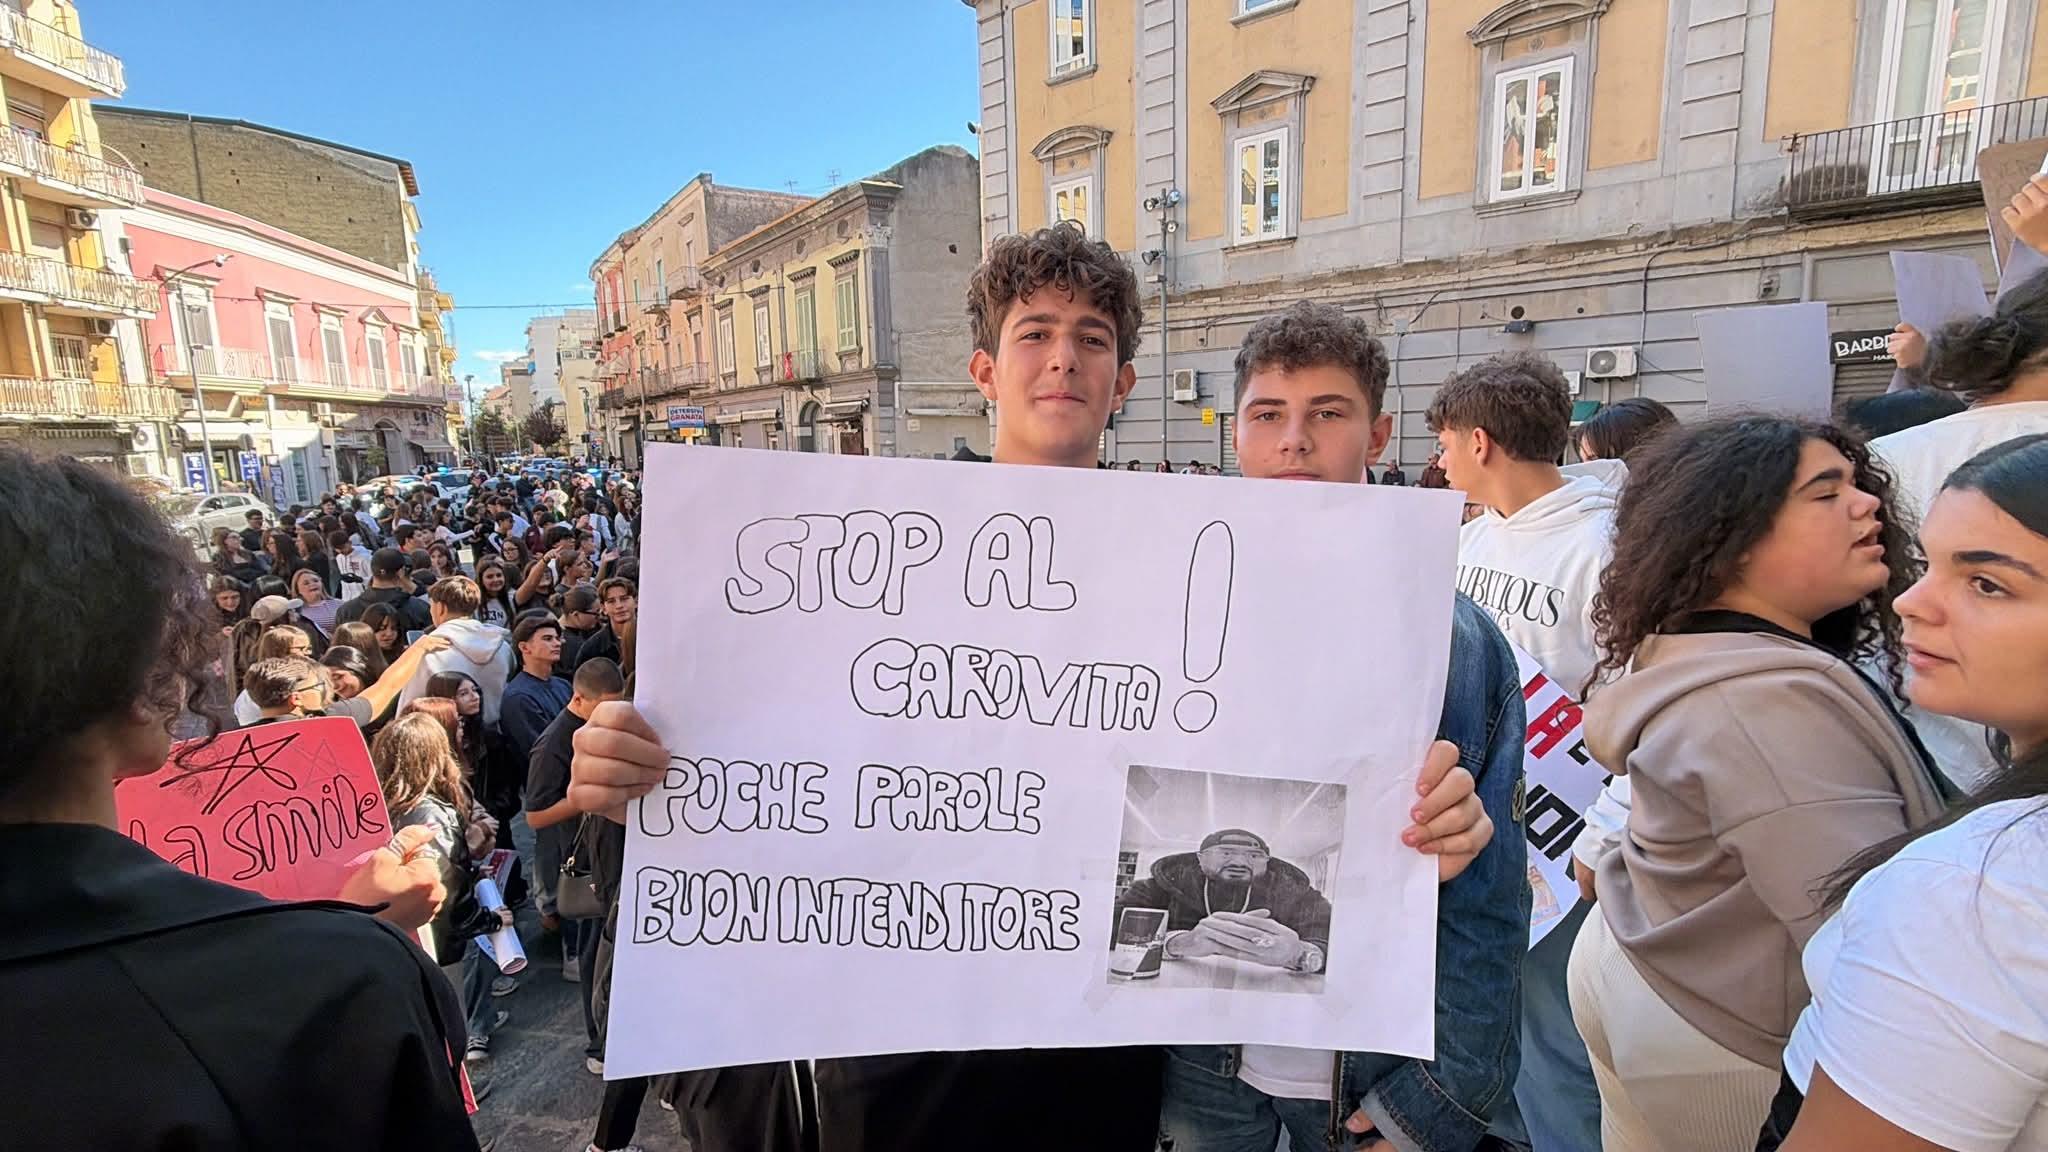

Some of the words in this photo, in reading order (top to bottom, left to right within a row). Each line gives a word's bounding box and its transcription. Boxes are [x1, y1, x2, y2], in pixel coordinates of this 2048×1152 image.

[725, 510, 942, 615] STOP
[965, 513, 1076, 611] AL
[851, 638, 1160, 730] CAROVITA
[223, 774, 384, 881] smile
[640, 757, 828, 836] POCHE
[855, 764, 1045, 834] PAROLE
